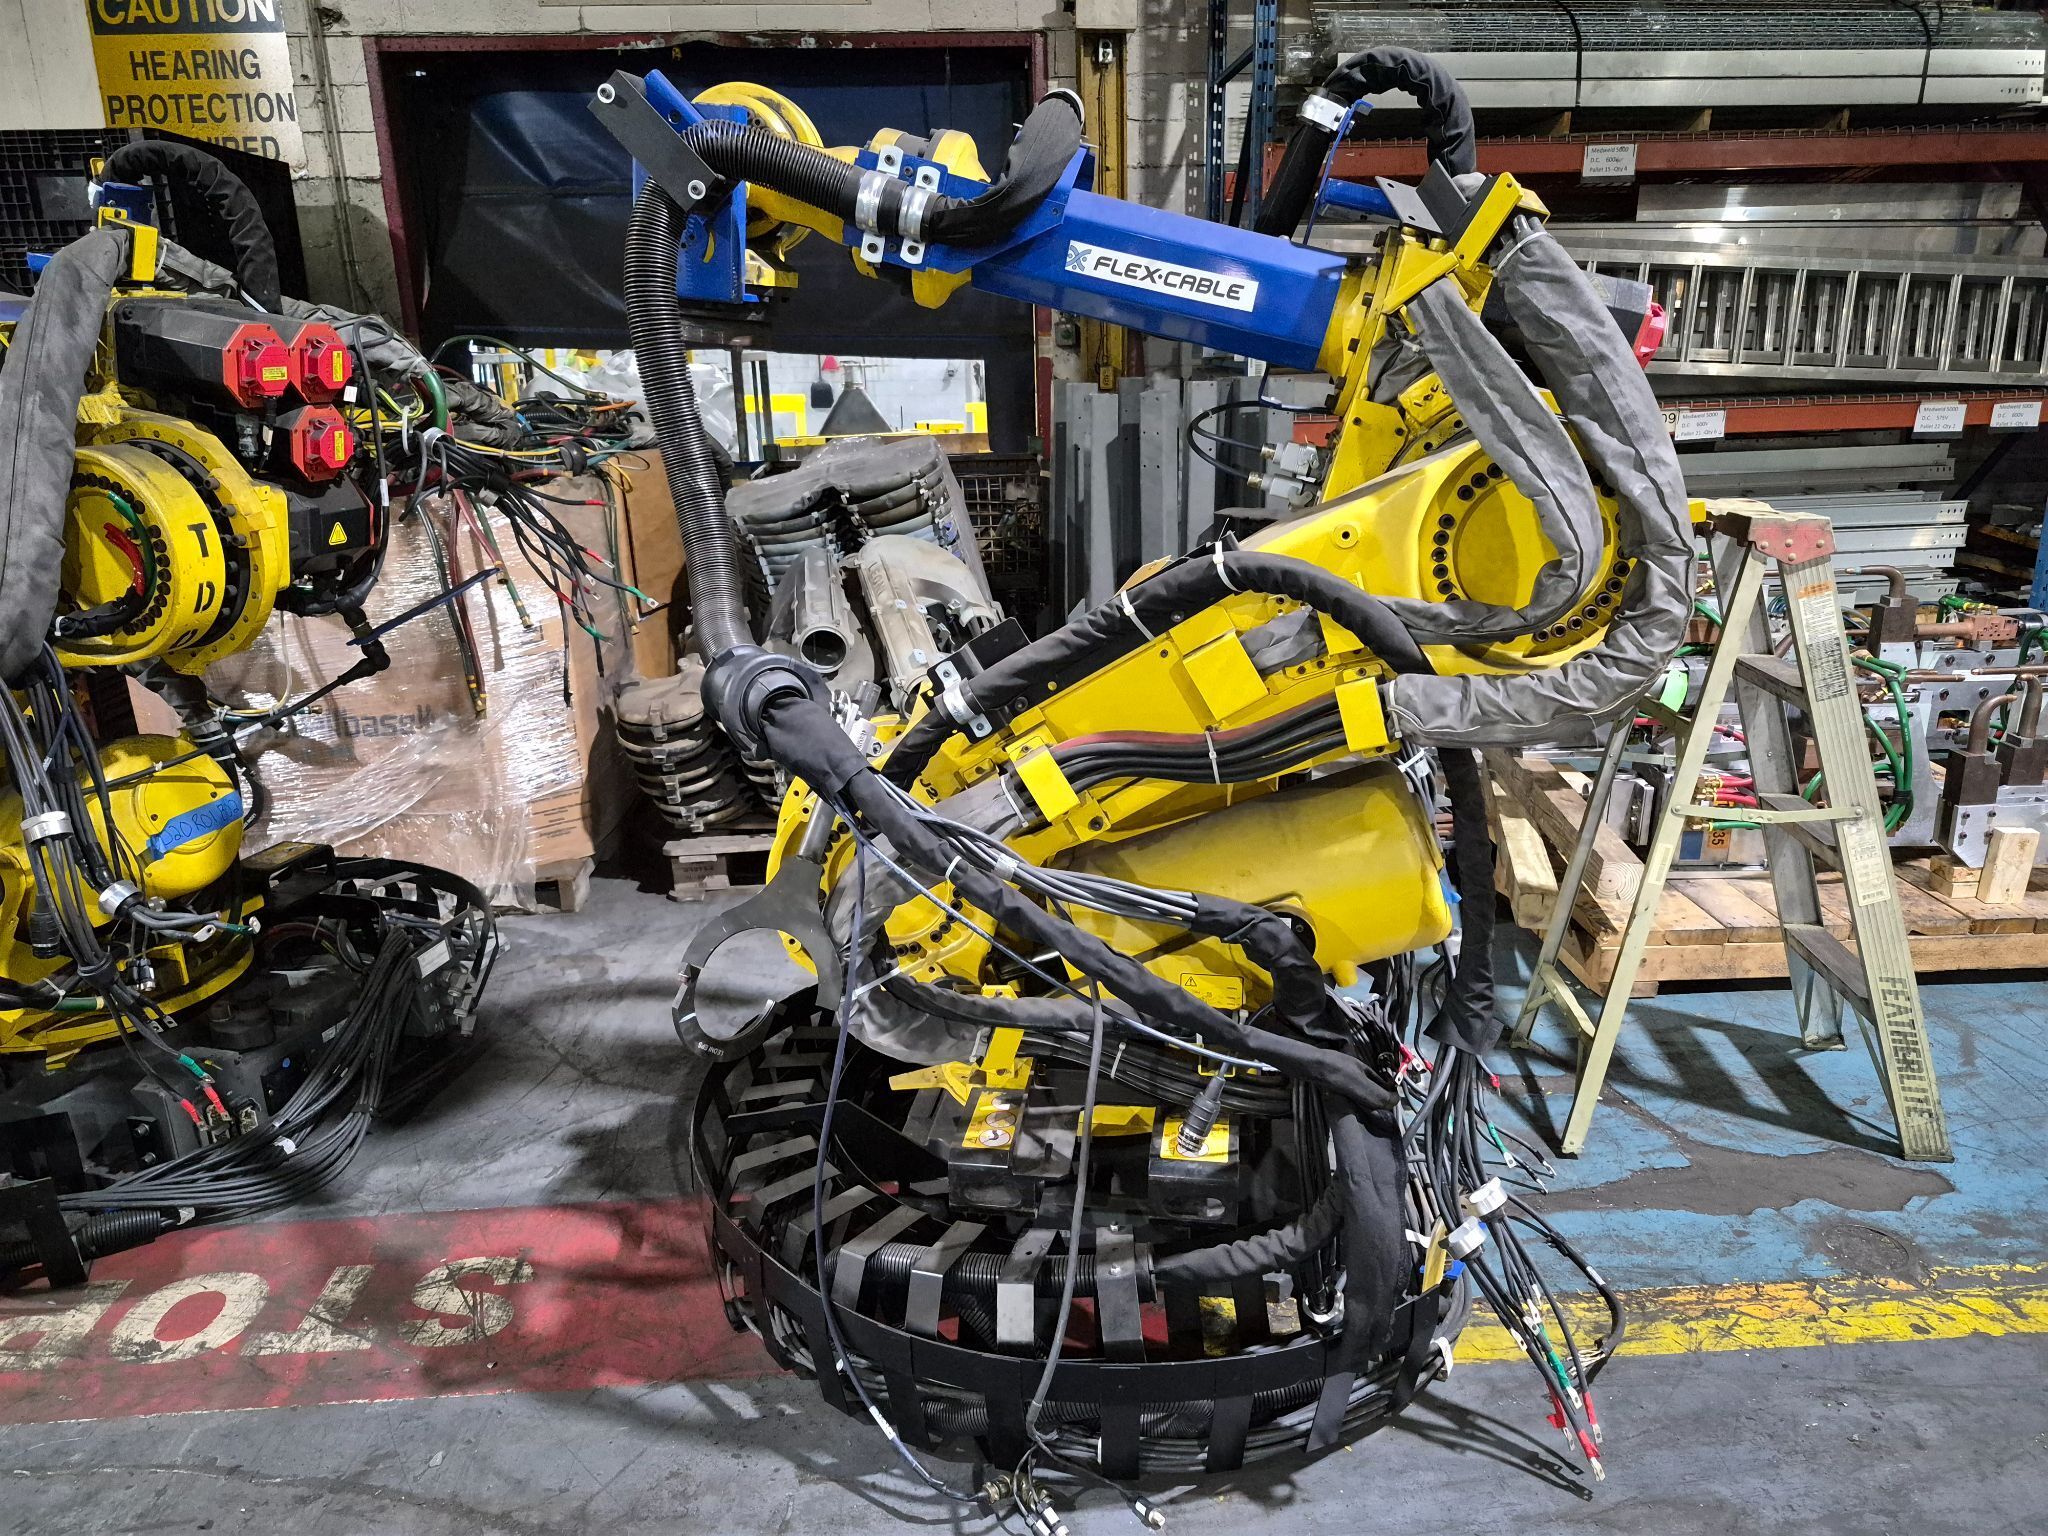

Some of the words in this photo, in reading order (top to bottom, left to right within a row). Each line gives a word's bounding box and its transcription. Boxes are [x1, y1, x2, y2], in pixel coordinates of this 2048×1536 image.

[129, 48, 262, 81] HEARING
[106, 92, 296, 125] PROTECTION
[1711, 830, 1726, 846] 35
[1879, 976, 1935, 1119] FEATHERLITE
[0, 1255, 535, 1372] STOP
